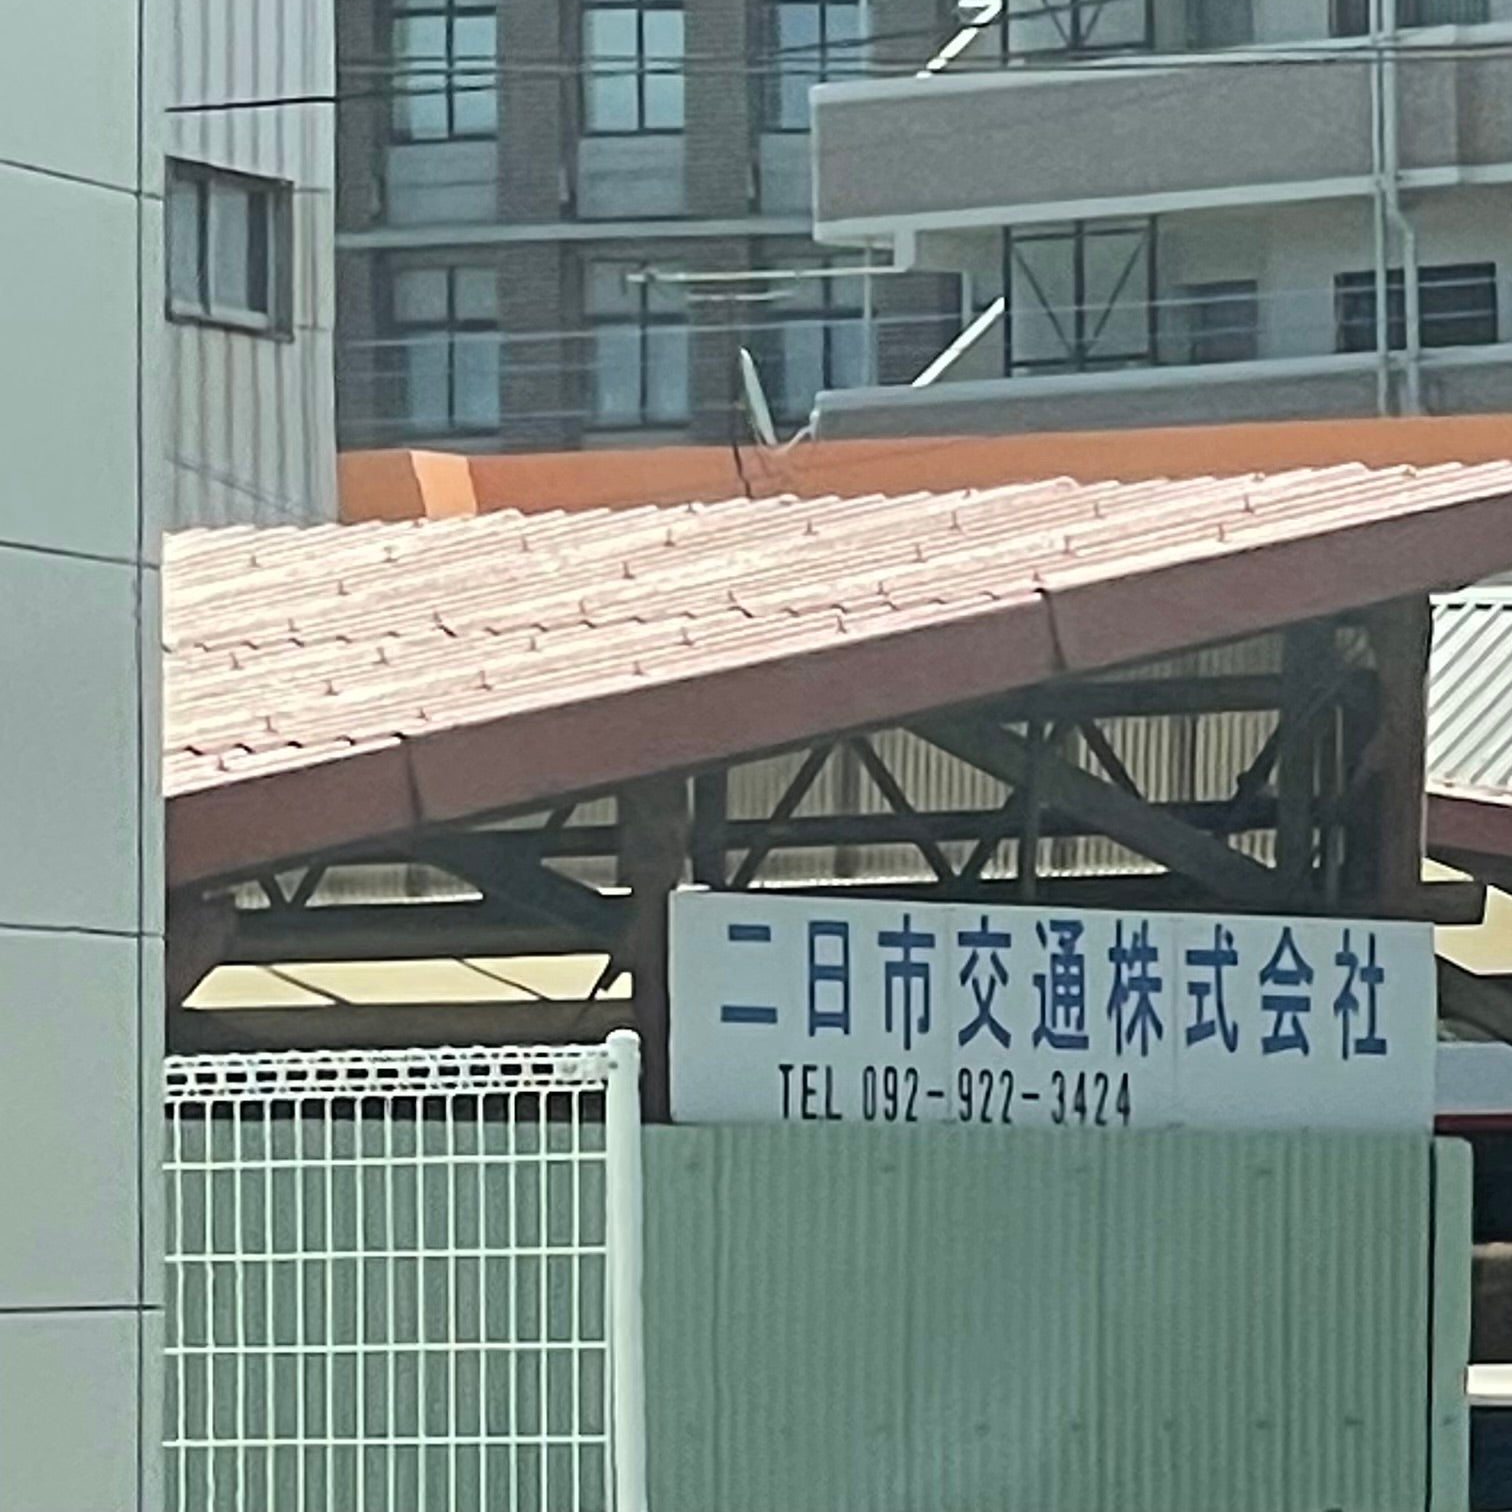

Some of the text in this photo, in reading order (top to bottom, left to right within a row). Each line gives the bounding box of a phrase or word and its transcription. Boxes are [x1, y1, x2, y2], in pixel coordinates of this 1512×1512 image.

[719, 913, 1388, 1061] 二日市交通株式会社
[778, 1064, 1131, 1127] TEL 092-922-3424
